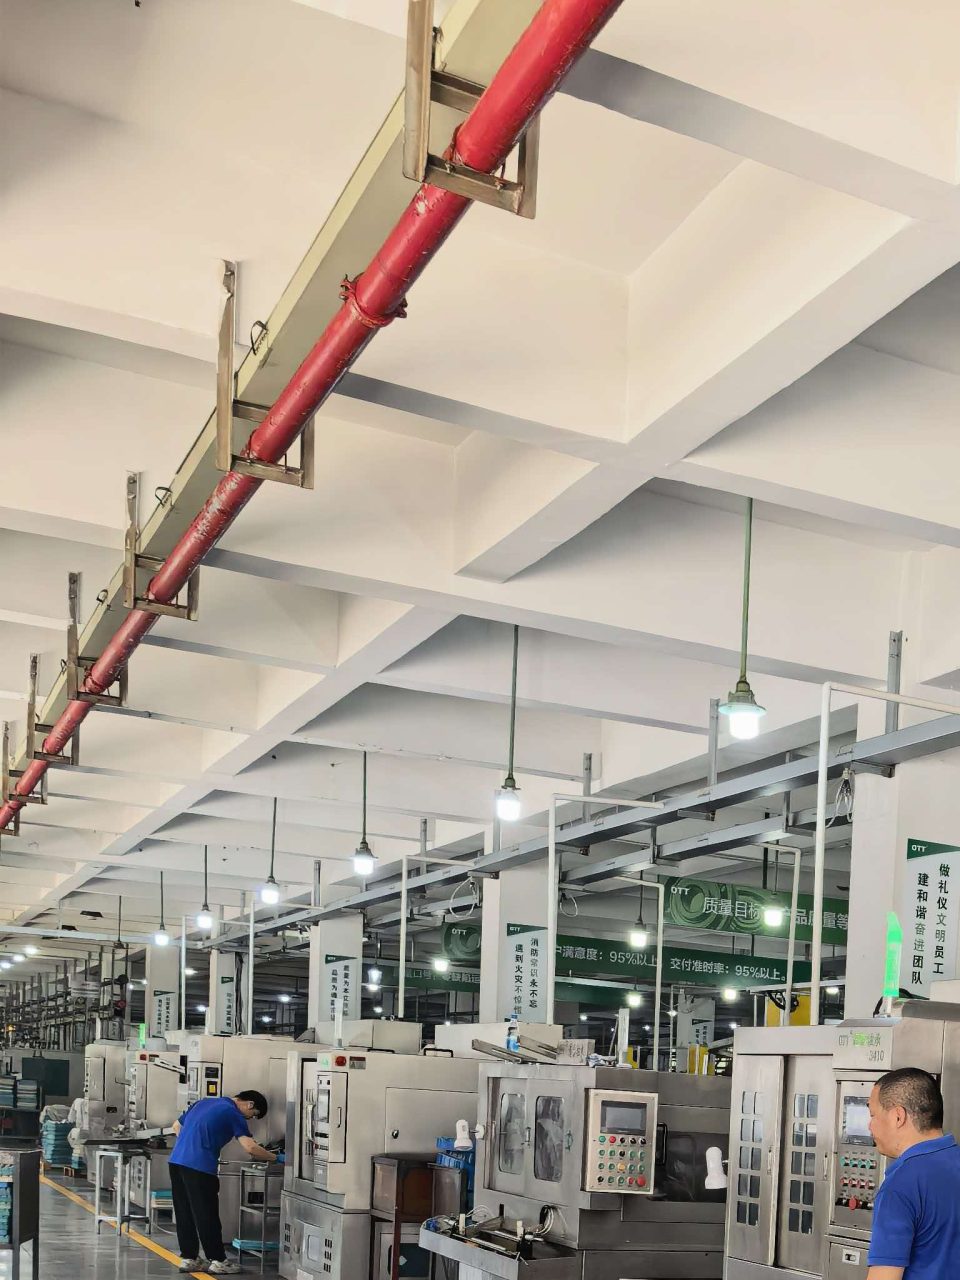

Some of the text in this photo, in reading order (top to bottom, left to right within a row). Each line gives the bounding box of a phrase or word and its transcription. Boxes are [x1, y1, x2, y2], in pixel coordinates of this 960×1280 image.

[670, 886, 690, 895] OTT
[911, 873, 929, 985] 建和谐奋进团队
[932, 863, 951, 974] 做礼仪文明员工
